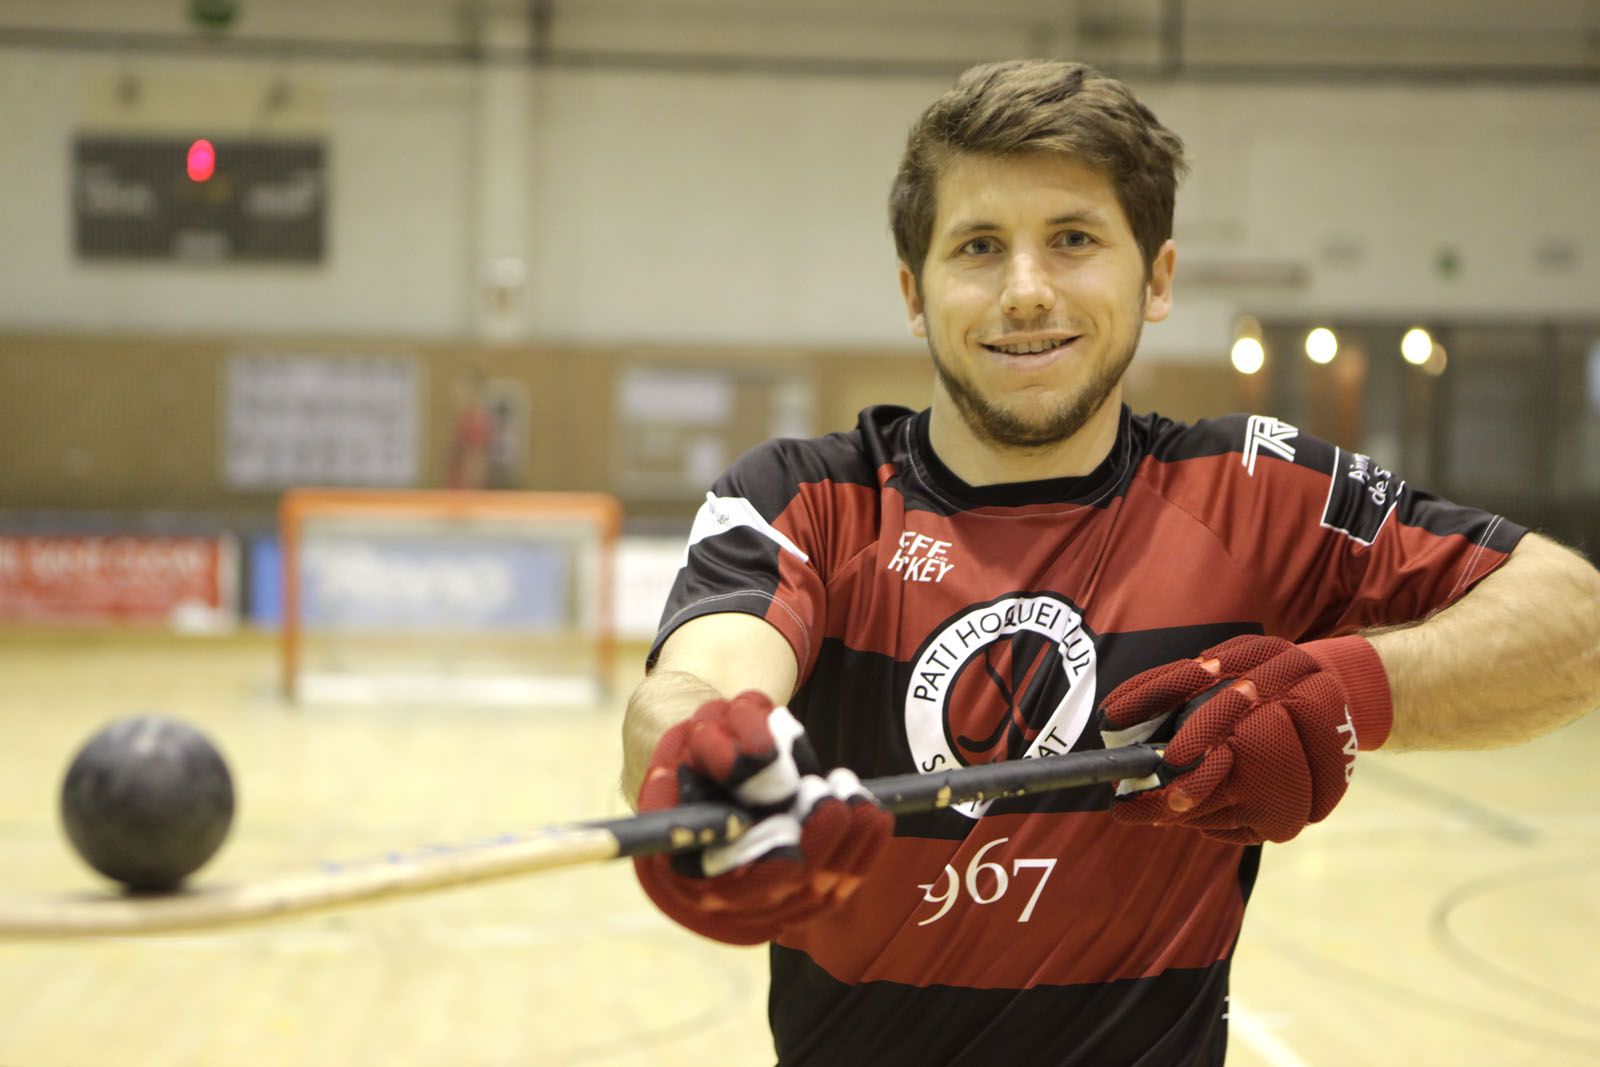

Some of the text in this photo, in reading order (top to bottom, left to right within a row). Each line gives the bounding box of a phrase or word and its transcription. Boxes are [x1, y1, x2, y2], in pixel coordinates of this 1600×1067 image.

[1368, 480, 1389, 505] de
[913, 642, 958, 702] PATI
[917, 837, 1058, 927] 967
